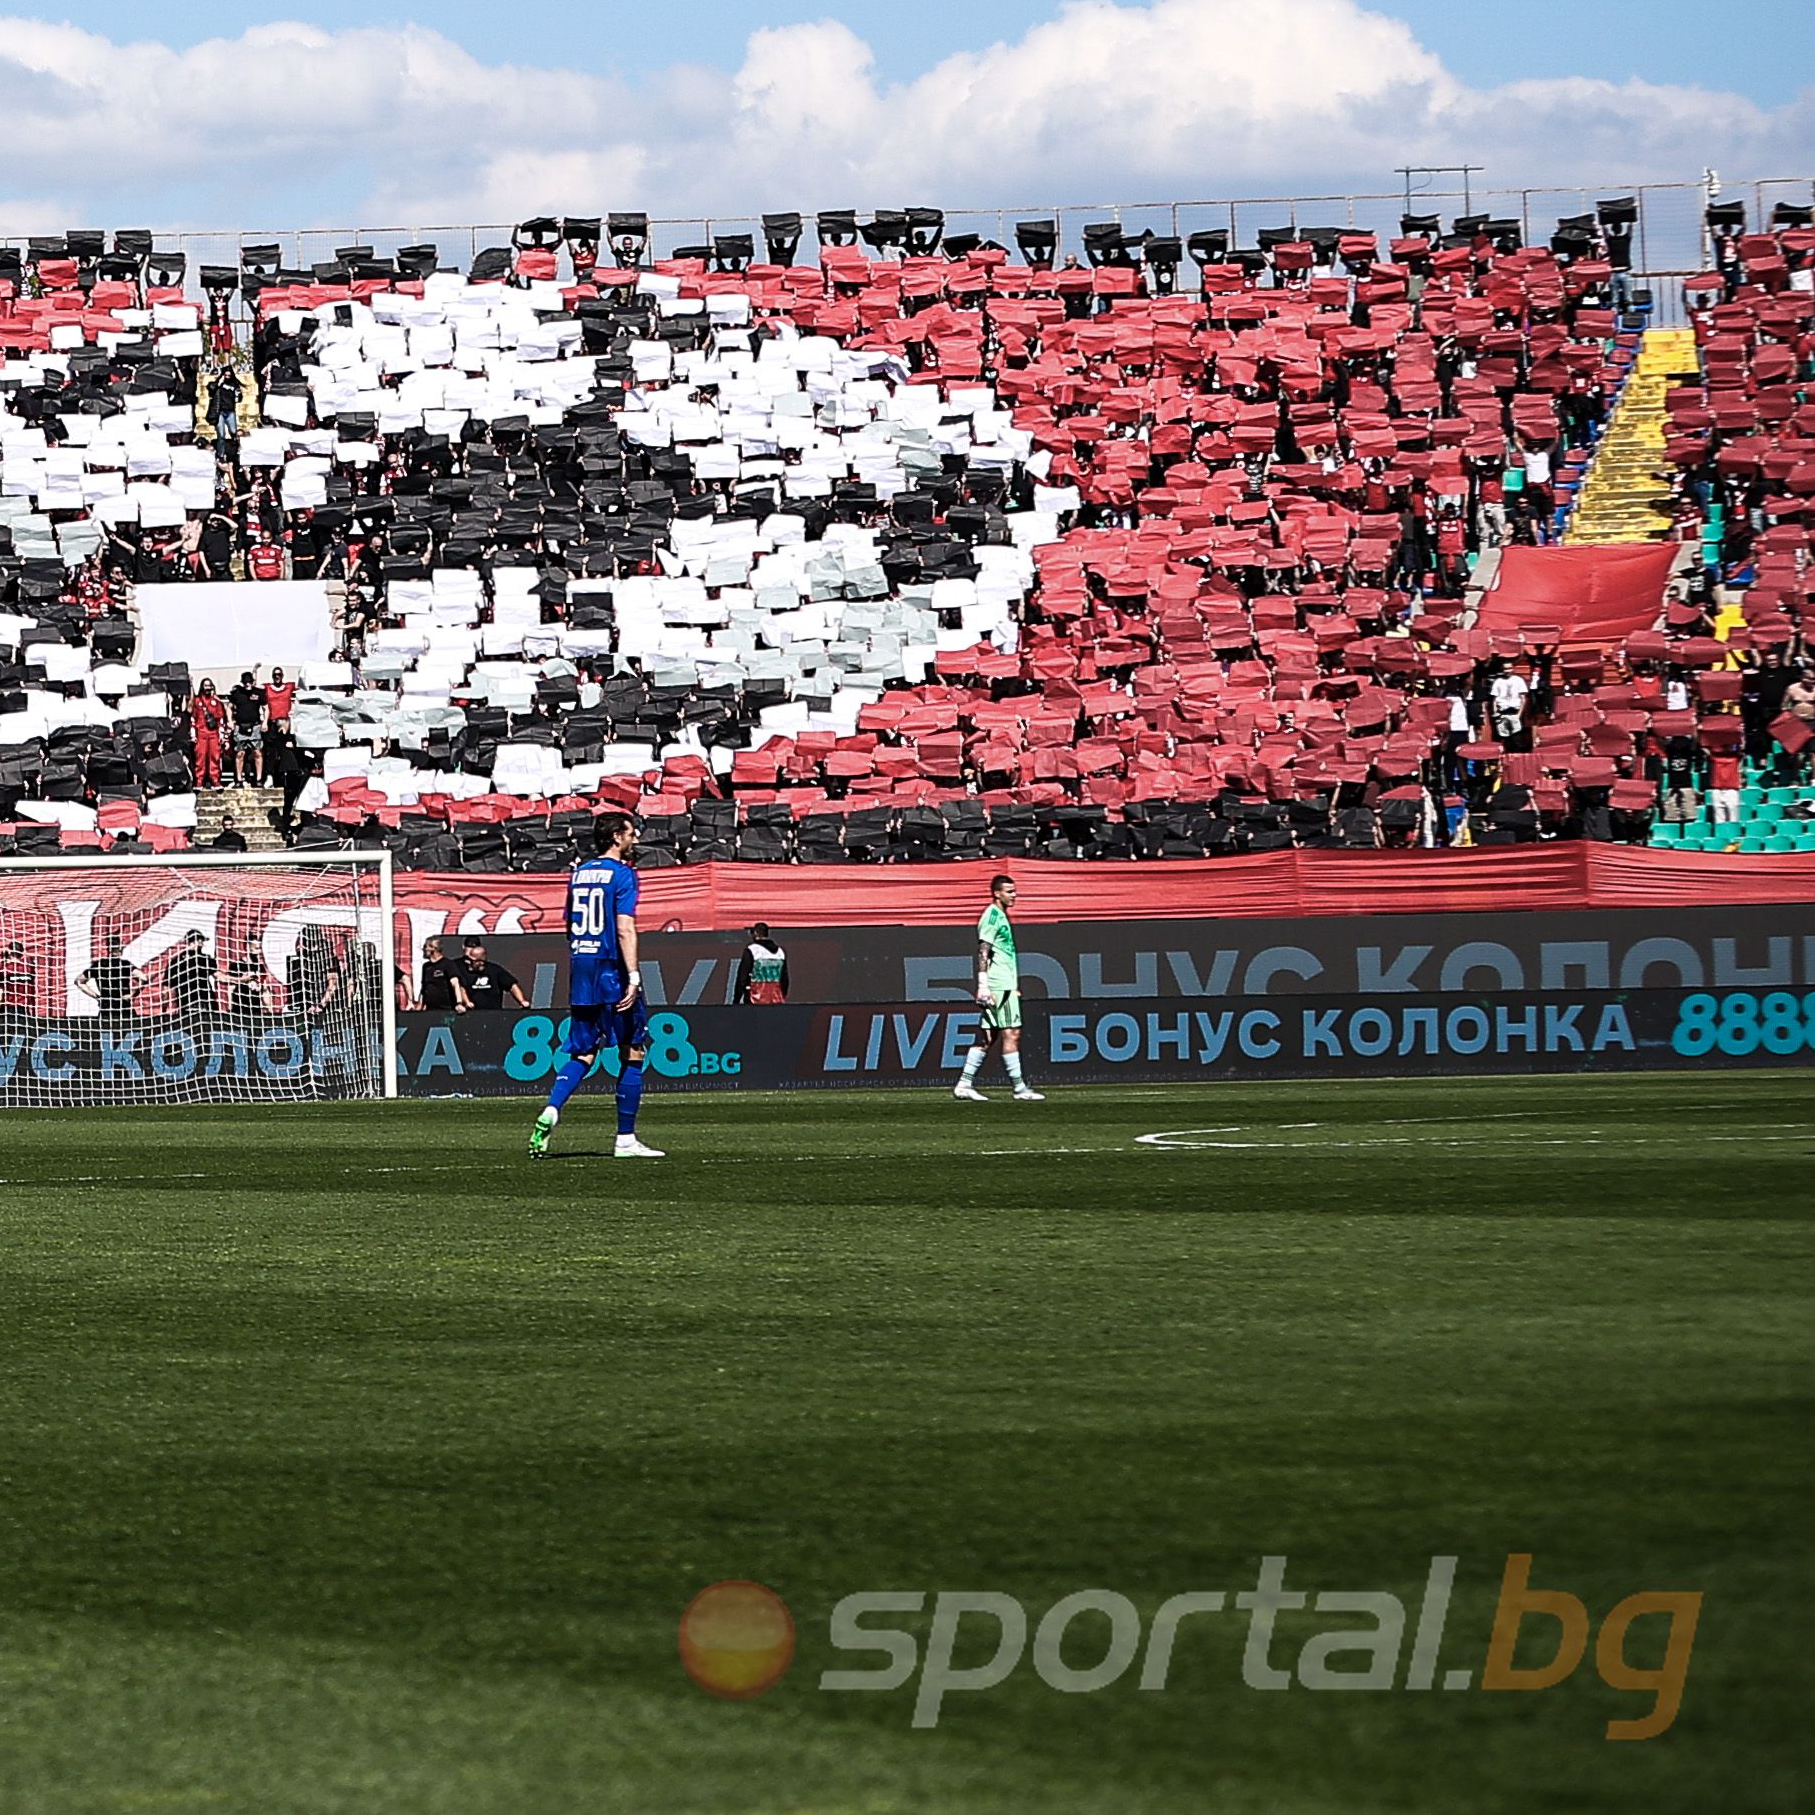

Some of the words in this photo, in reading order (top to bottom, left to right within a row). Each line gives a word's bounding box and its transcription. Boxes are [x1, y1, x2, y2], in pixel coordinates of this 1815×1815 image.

[571, 887, 604, 936] 50
[1357, 935, 1815, 992] КОЛОН
[504, 1012, 741, 1081] 88.BG
[823, 1013, 983, 1071] LIVE
[1050, 1009, 1281, 1065] БОНУС
[1303, 1003, 1636, 1057] КОЛОНКА
